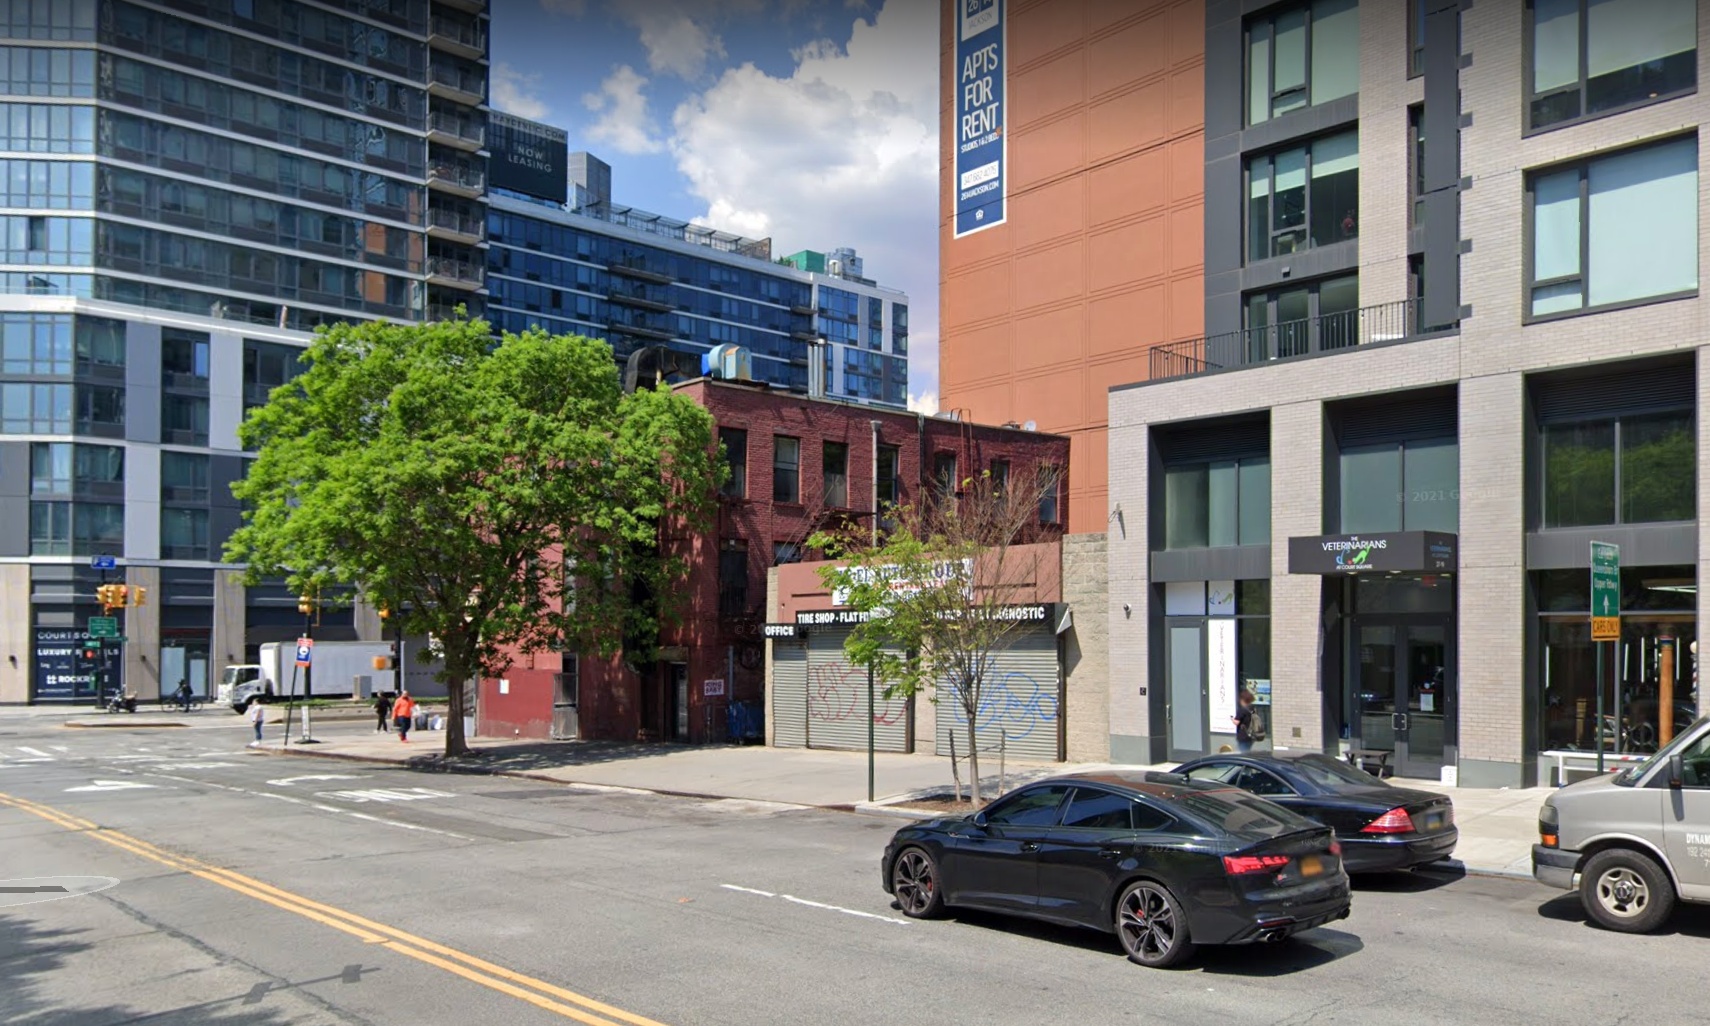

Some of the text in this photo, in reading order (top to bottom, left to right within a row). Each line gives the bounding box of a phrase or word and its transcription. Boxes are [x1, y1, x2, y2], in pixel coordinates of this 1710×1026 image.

[962, 43, 998, 83] APTS
[964, 76, 993, 111] FOR
[962, 102, 999, 141] RENT
[518, 146, 543, 161] NOW
[508, 153, 552, 173] LEASING
[1322, 539, 1387, 551] VETERINARIANS
[797, 613, 814, 624] TIRE
[815, 613, 835, 623] SHOP
[839, 612, 859, 623] FLAT
[765, 625, 794, 636] OFFICE
[37, 648, 73, 656] LUXURY
